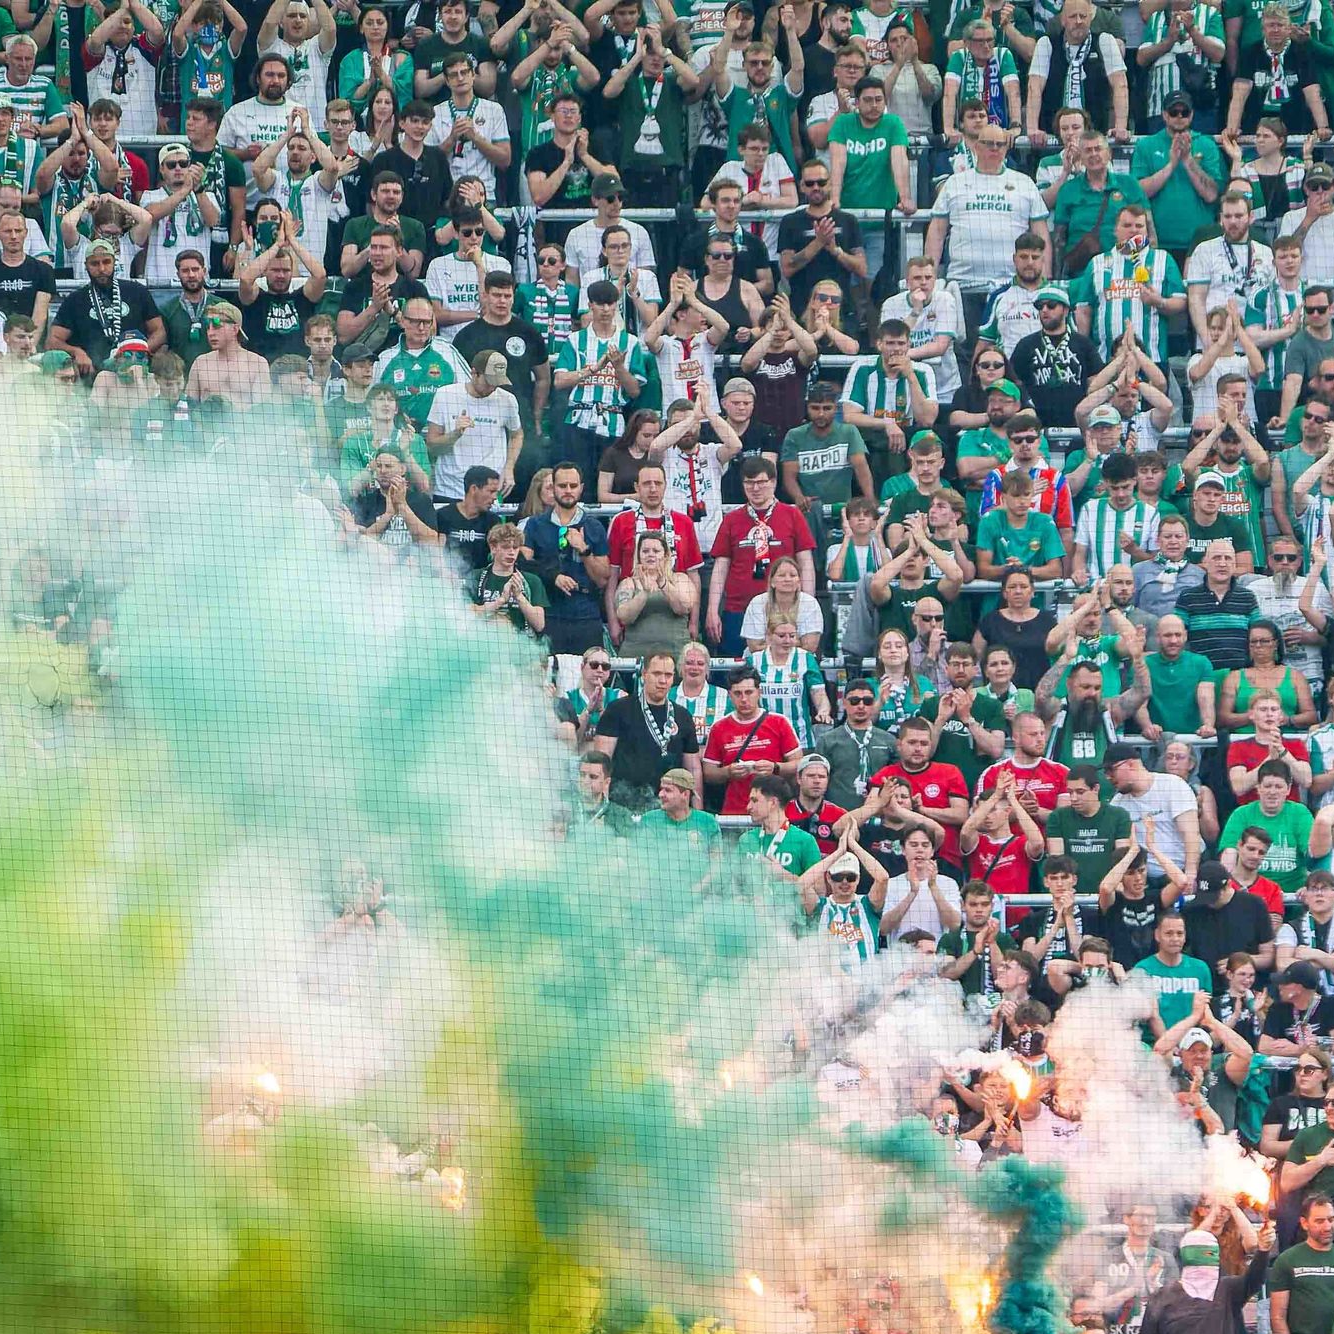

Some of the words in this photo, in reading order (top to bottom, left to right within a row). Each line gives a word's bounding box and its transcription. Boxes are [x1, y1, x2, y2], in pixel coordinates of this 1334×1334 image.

[846, 137, 887, 156] RAPID
[975, 194, 1006, 203] WIEN
[965, 202, 1013, 212] ENERGIE
[802, 450, 843, 471] RAPID
[760, 685, 789, 698] llianz
[1072, 739, 1096, 759] 88
[1271, 862, 1297, 873] WIEN
